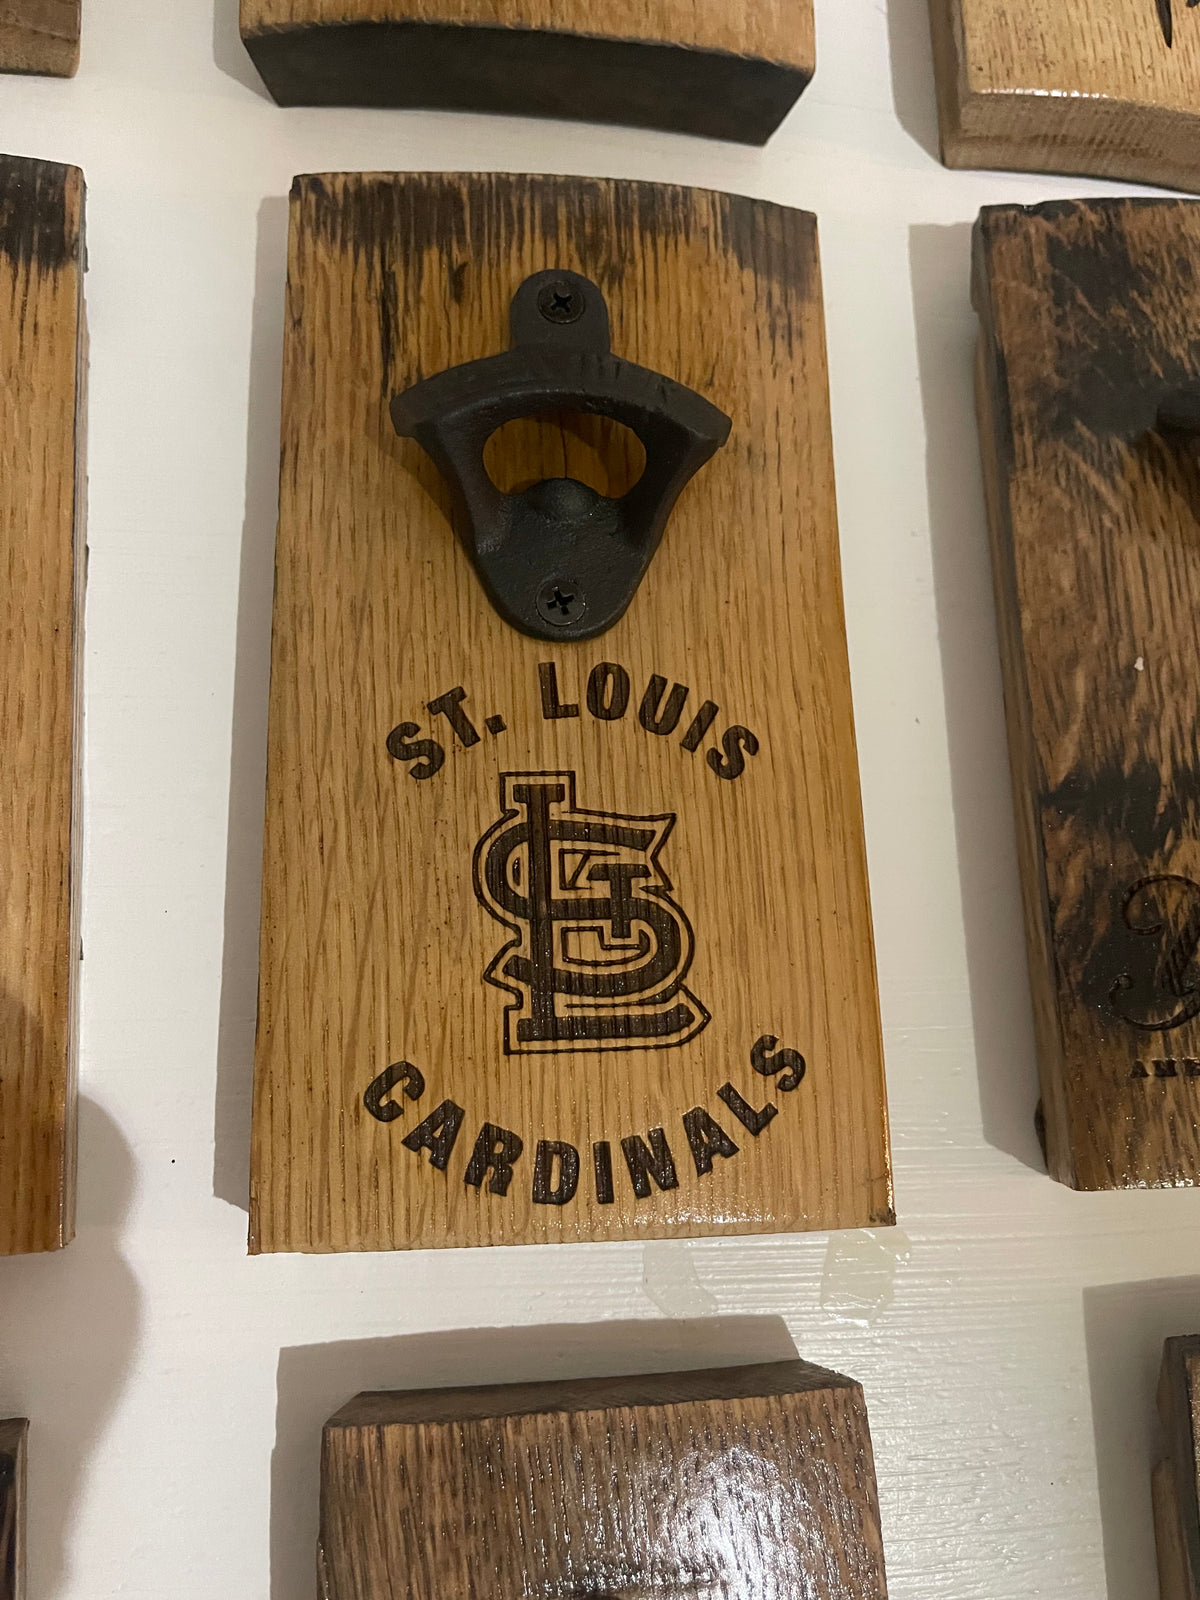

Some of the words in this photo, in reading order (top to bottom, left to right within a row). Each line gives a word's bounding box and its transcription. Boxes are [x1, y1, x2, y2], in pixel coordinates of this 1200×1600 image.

[386, 687, 507, 779] ST.
[538, 662, 759, 779] LOUIS
[364, 1034, 807, 1205] CARDINALS
